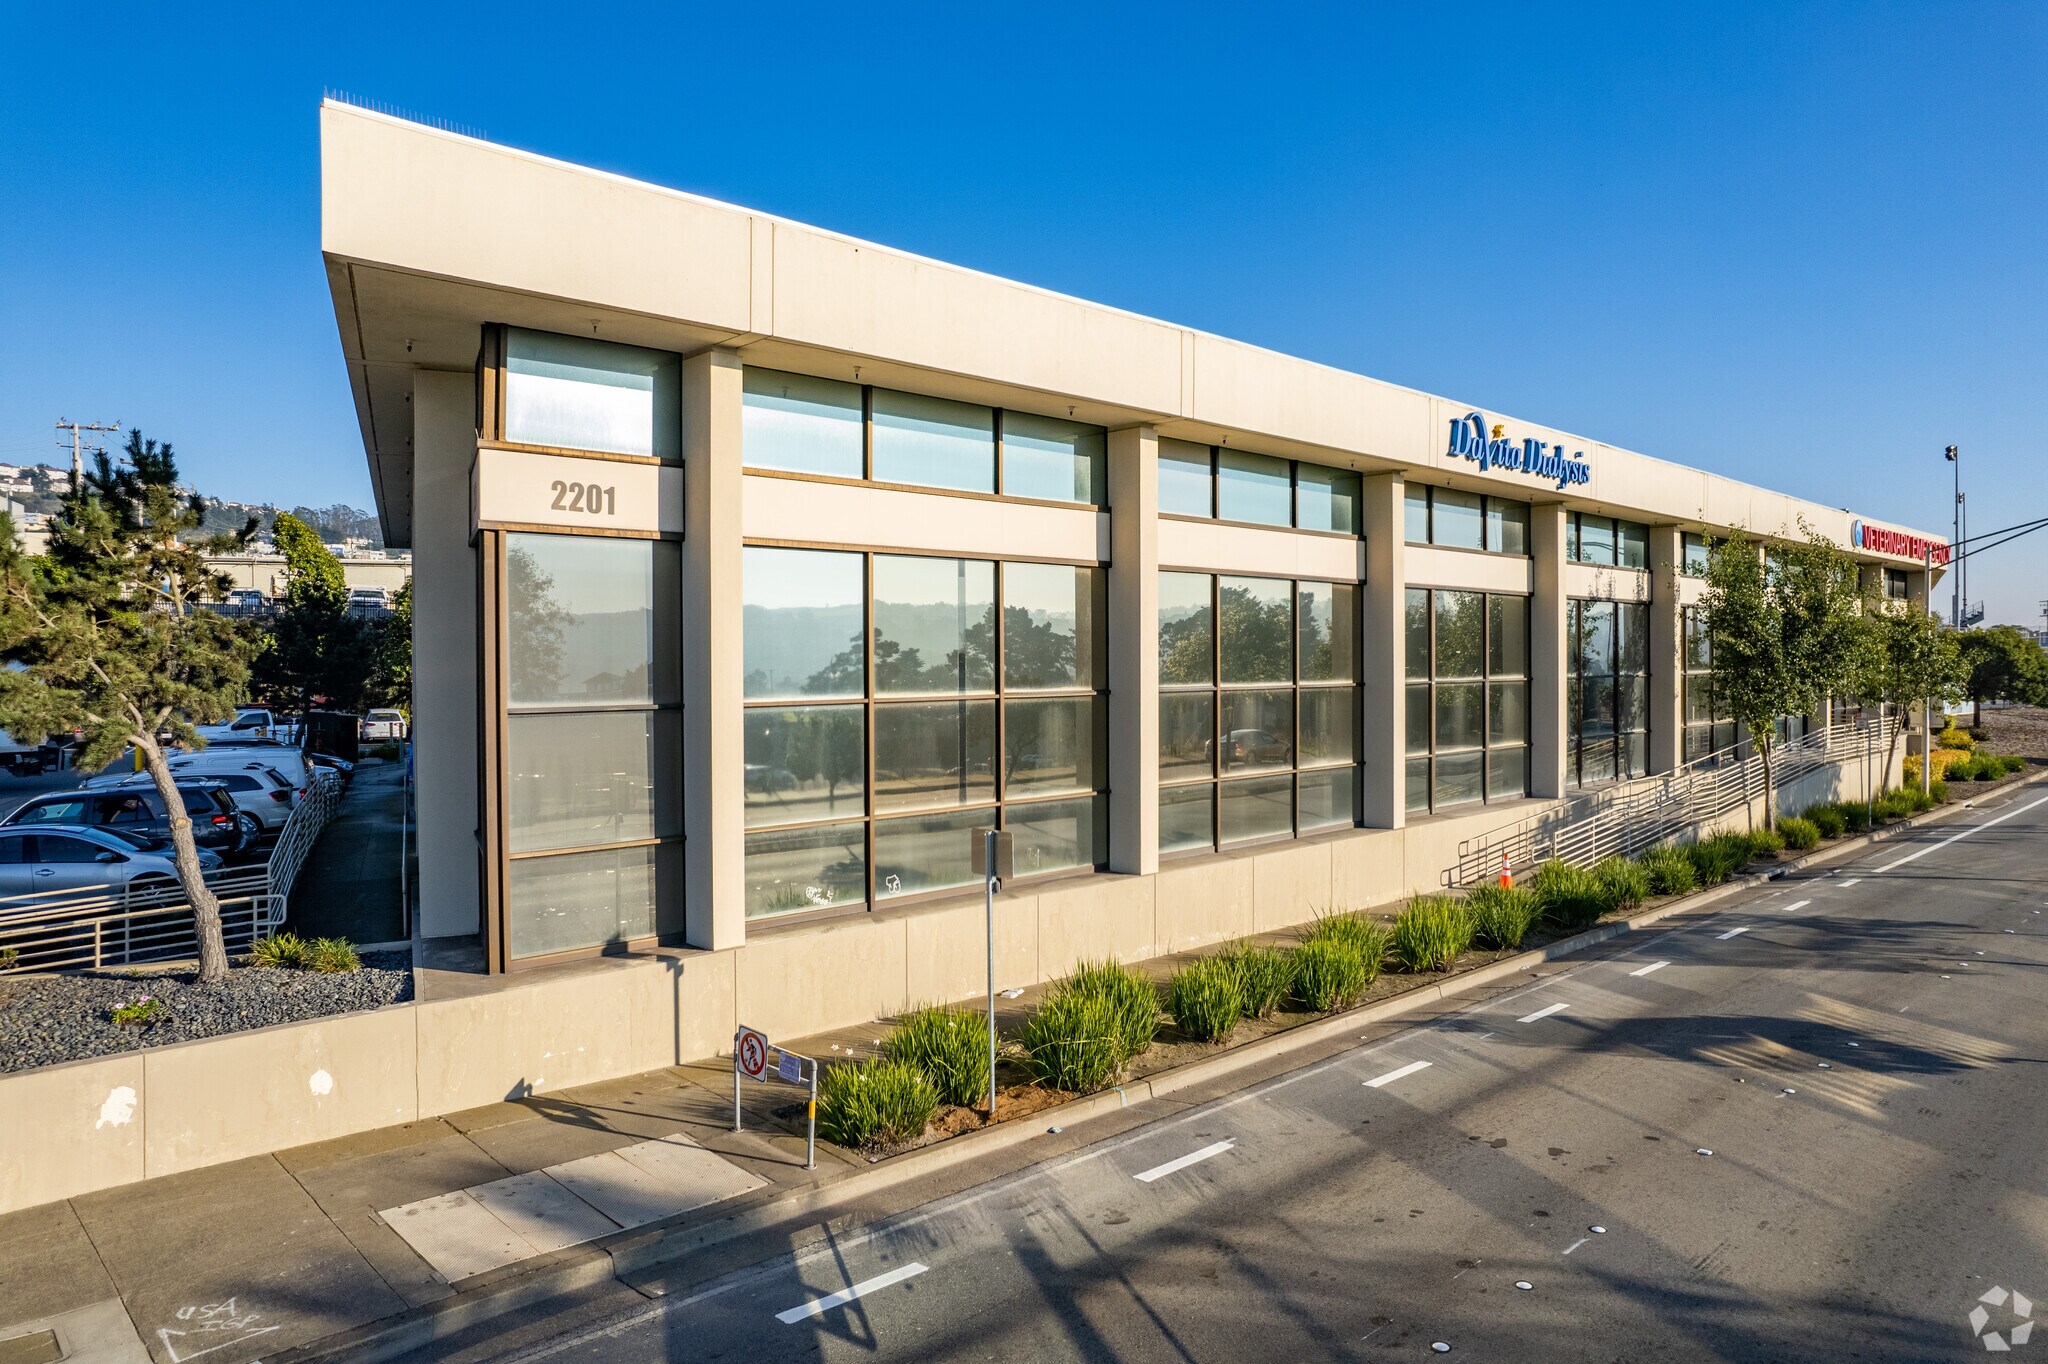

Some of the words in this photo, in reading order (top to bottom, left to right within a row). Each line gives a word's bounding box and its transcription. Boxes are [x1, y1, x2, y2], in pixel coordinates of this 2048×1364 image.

[1447, 412, 1522, 473] DaVita
[1521, 438, 1591, 491] Dialysis
[551, 480, 615, 515] 2201
[1863, 525, 1910, 556] VETERINARY
